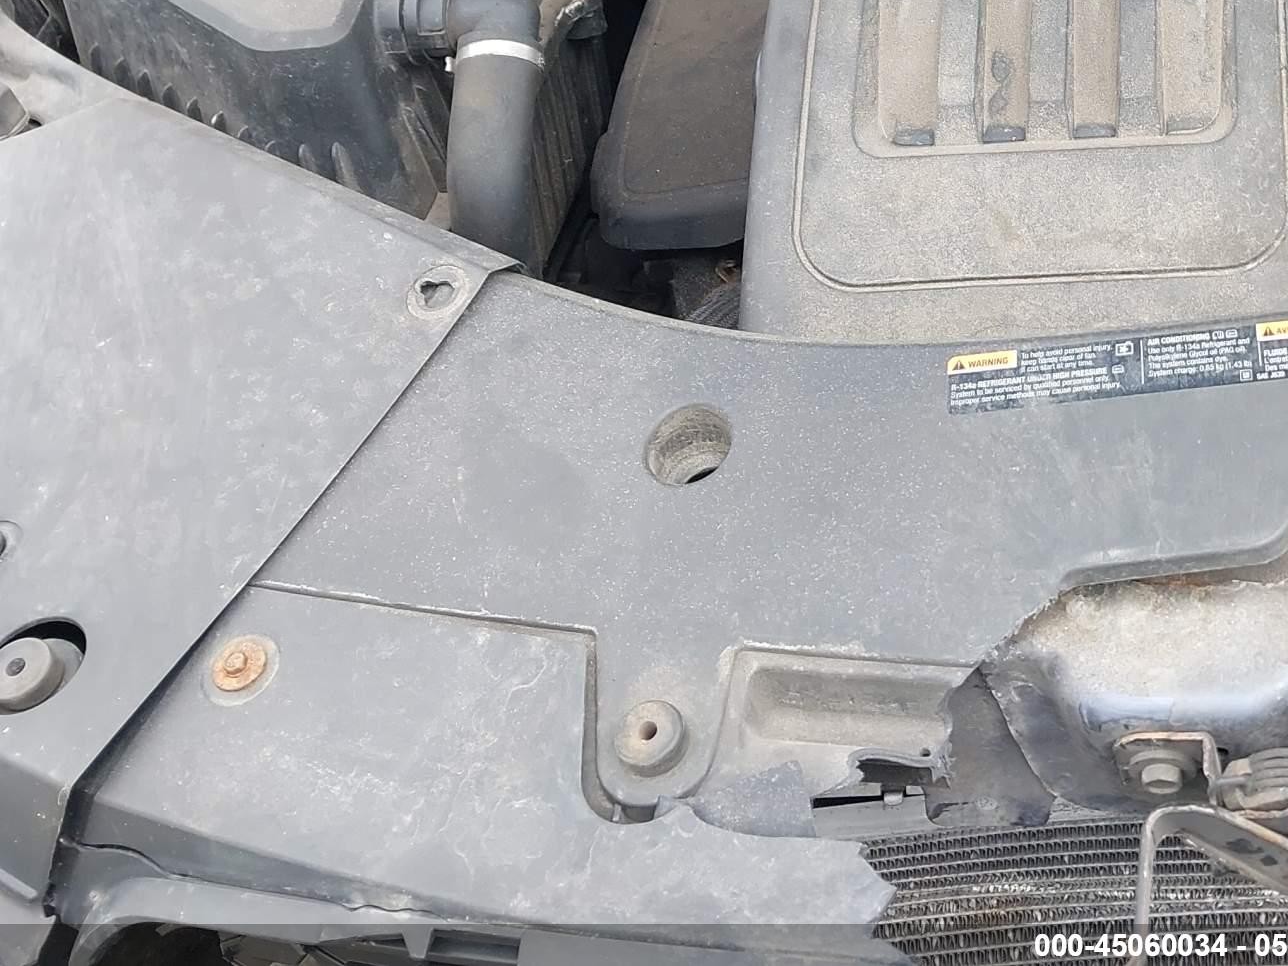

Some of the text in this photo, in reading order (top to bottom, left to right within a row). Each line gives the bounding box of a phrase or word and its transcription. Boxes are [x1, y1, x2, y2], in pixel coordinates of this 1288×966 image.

[1147, 337, 1159, 346] AIR
[1021, 352, 1028, 360] To
[1030, 351, 1043, 359] help
[1045, 349, 1062, 357] avoid
[1064, 346, 1091, 356] personal
[967, 357, 1008, 369] WARNING
[977, 376, 1025, 388] REFRIGERANT
[951, 389, 975, 399] System
